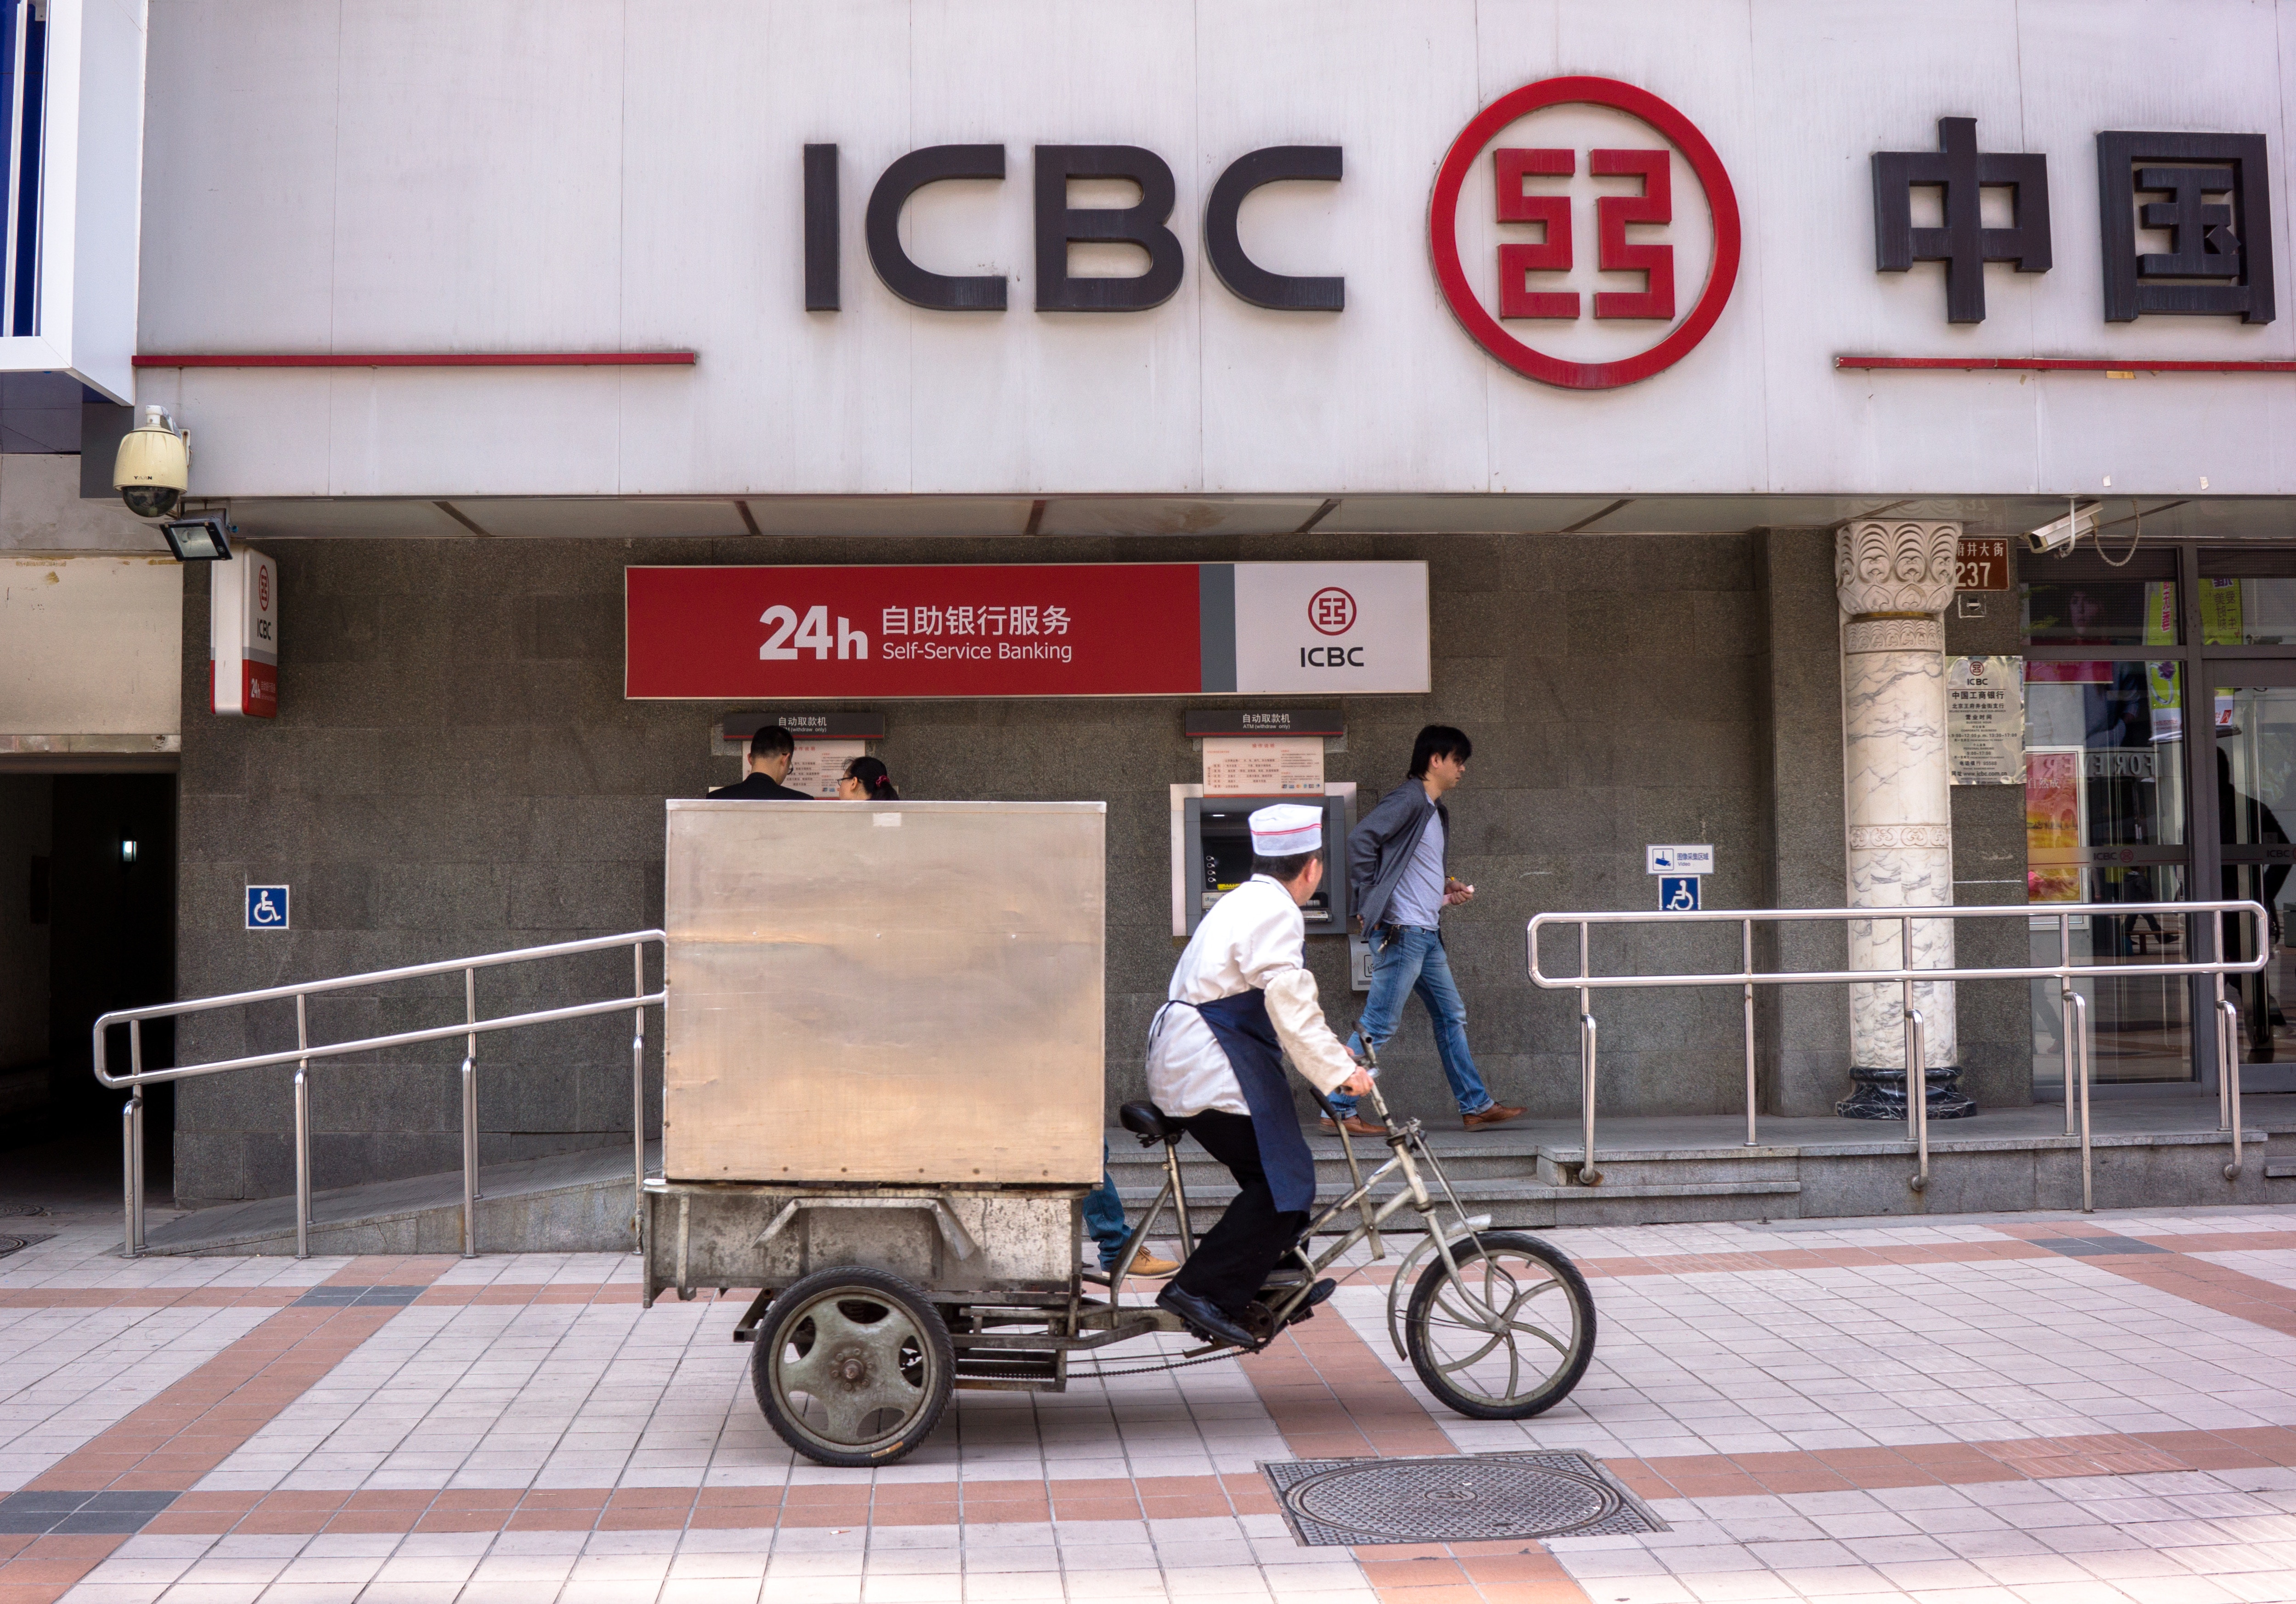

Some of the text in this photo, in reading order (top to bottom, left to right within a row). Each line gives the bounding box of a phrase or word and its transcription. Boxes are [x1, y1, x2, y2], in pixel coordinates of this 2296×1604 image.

[804, 143, 1345, 311] ICBC
[1871, 117, 2276, 324] 中国
[1956, 562, 1991, 587] 237
[257, 618, 271, 641] ICBC
[882, 606, 1071, 636] 自助银行服务
[759, 605, 868, 660] 24h
[882, 642, 1073, 663] Self-Service Banking
[1300, 647, 1364, 667] ICBC
[251, 678, 261, 699] 24h
[1952, 691, 2004, 699] 中国工商银行
[778, 716, 827, 726] 自动取款机
[1243, 714, 1290, 723] 自动取款机
[2093, 852, 2117, 861] ICBC
